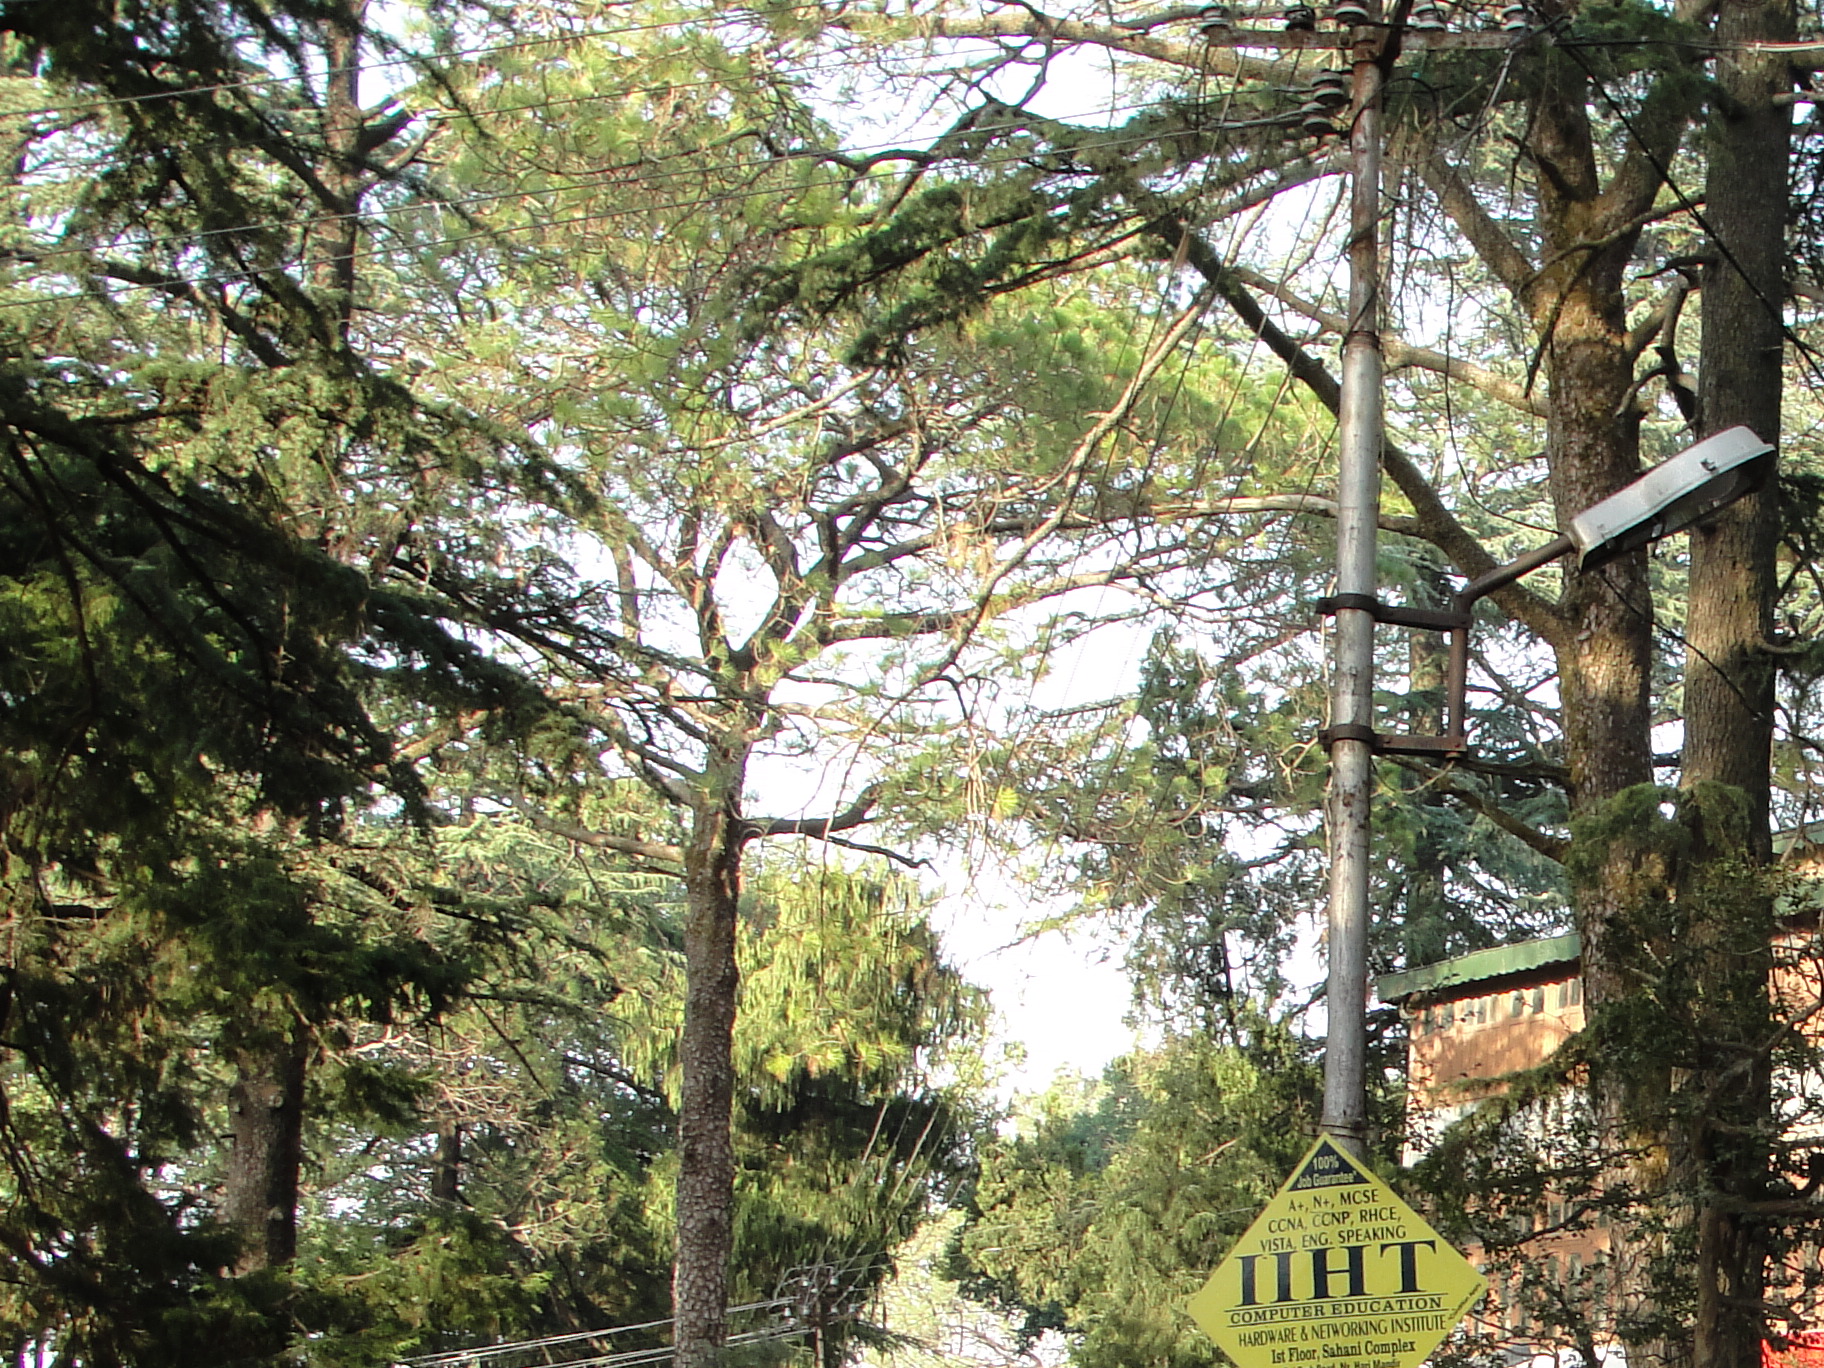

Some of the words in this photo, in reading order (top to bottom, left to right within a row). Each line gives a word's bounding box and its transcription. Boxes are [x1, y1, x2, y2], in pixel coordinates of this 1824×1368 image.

[1312, 1155, 1340, 1170] 100%
[1340, 1189, 1379, 1206] MCSE
[1302, 1232, 1334, 1249] ENG.
[1338, 1225, 1407, 1245] SPEAKING
[1234, 1240, 1437, 1308] IIHT
[1230, 1304, 1326, 1325] COMPUTER
[1332, 1297, 1443, 1316] EDUCATION
[1238, 1328, 1298, 1348] HARDWARE
[1300, 1325, 1309, 1342] &
[1310, 1318, 1389, 1339] NETWORKING
[1390, 1314, 1448, 1332] INSTITUTE
[1288, 1346, 1322, 1364] Floor,
[1322, 1340, 1363, 1358] Sahani
[1364, 1338, 1417, 1358] Complex
